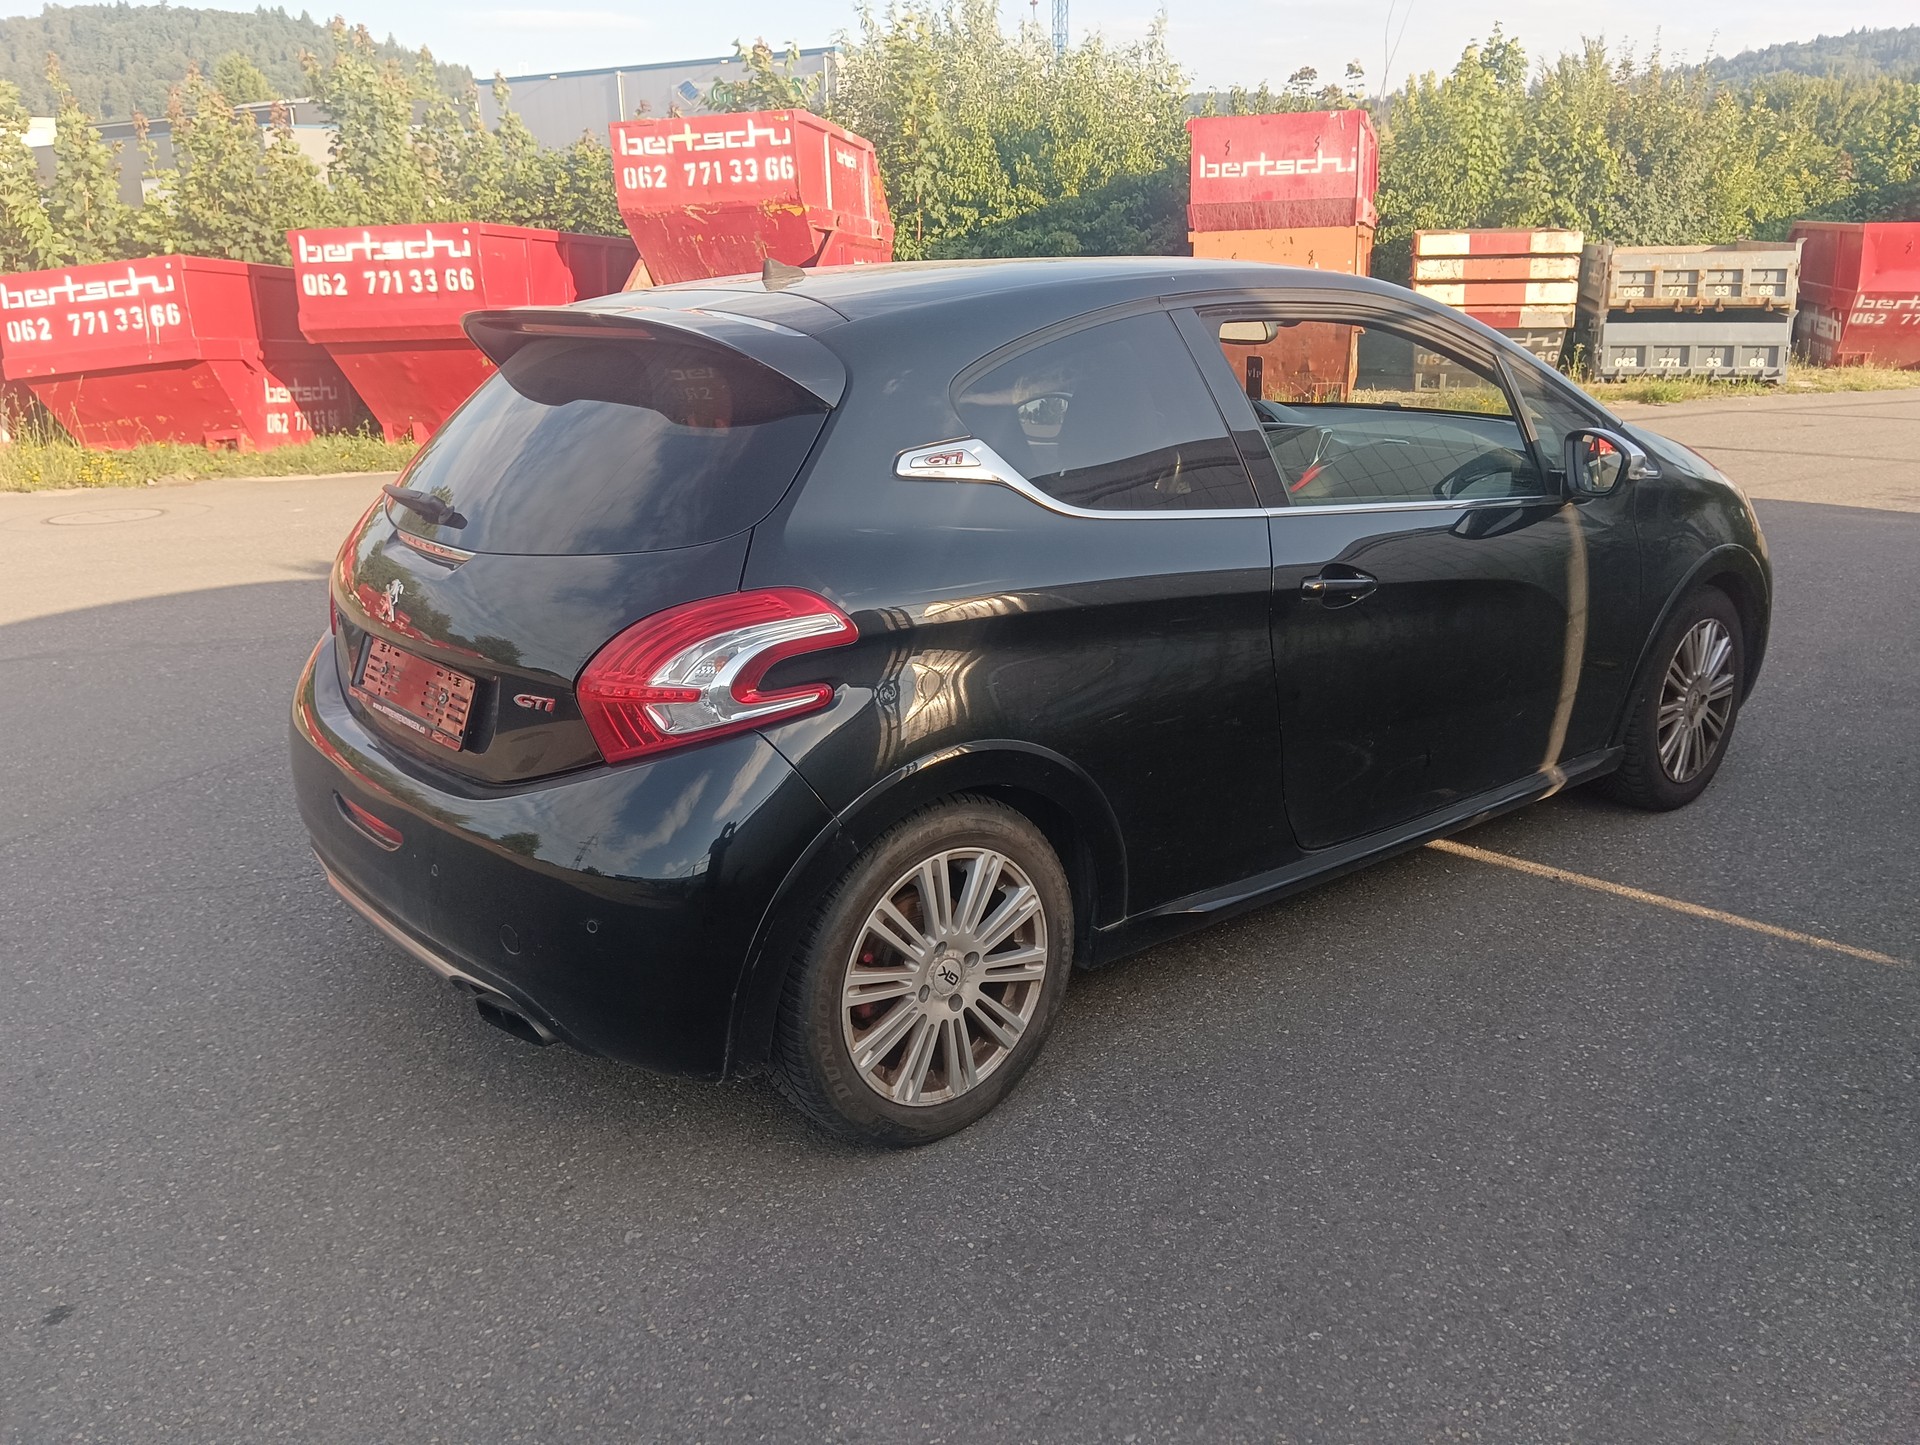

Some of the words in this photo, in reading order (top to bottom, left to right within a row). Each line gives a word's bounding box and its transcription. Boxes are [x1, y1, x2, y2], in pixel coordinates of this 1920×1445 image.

[619, 115, 791, 155] bertschi
[623, 165, 667, 189] 062
[683, 161, 722, 187] 771
[729, 158, 758, 183] 33
[765, 155, 794, 180] 66
[1199, 147, 1357, 178] bertschi
[298, 227, 471, 263] bertschi
[0, 262, 175, 309] bertschi
[302, 273, 348, 296] 062
[363, 270, 403, 294] 771
[409, 268, 438, 293] 33
[445, 267, 475, 291] 66
[1623, 286, 1645, 297] 062
[1668, 286, 1688, 297] 771
[1714, 285, 1729, 296] 33
[1758, 285, 1774, 296] 66
[1856, 294, 1920, 310] bert
[6, 317, 52, 342] 062
[67, 310, 108, 336] 771
[114, 306, 144, 331] 33
[151, 303, 181, 327] 66
[1851, 312, 1887, 325] 062
[1615, 357, 1637, 368] 062
[1658, 357, 1680, 368] 771
[1706, 357, 1722, 368] 33
[1749, 357, 1765, 368] 66
[263, 377, 337, 404] bertschi
[266, 412, 289, 434] 062
